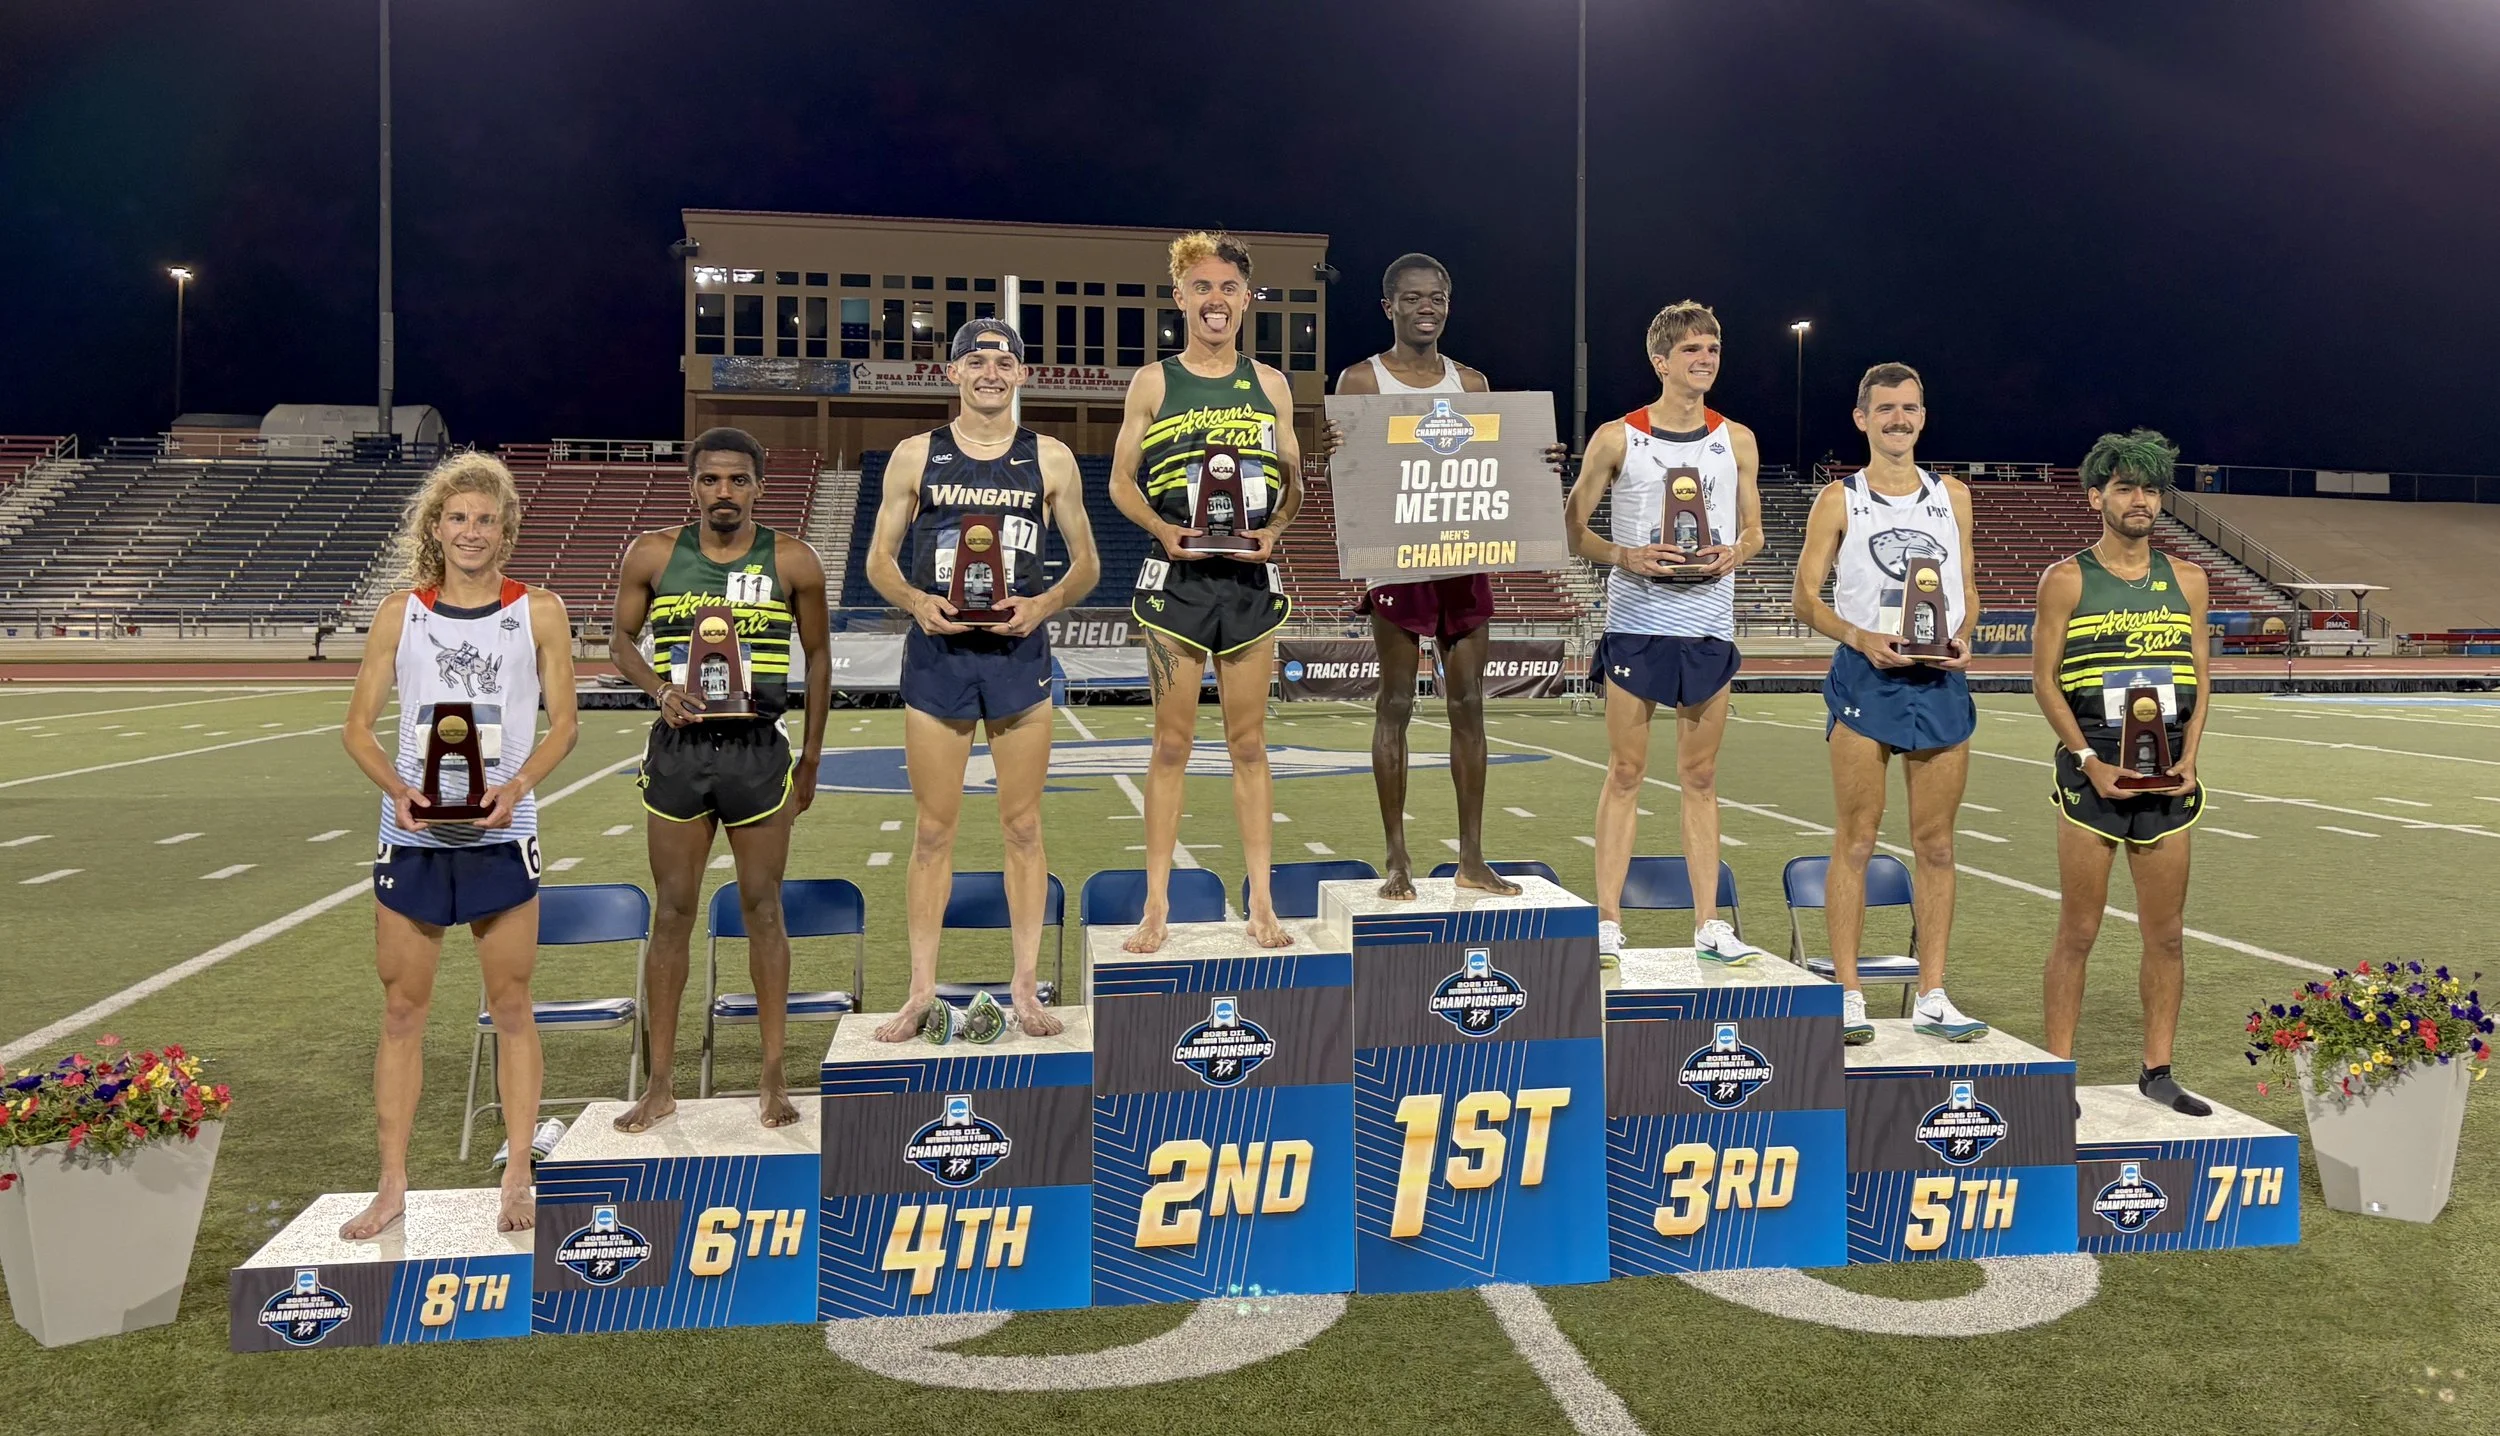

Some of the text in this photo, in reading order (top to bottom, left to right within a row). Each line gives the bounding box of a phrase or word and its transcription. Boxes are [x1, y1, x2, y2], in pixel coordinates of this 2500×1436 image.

[915, 364, 944, 374] PA
[1174, 403, 1254, 442] Adams
[1416, 427, 1474, 436] CHAMPIONSHIPS
[933, 454, 953, 464] SAC
[1212, 466, 1234, 474] NCAA
[1400, 458, 1498, 492] 10,000
[927, 484, 1036, 509] WINGATE
[1394, 490, 1510, 524] METERS
[1012, 520, 1033, 549] 17
[1440, 530, 1470, 541] MEN'S
[1396, 541, 1516, 568] CHAMPION
[736, 574, 762, 602] 11
[734, 612, 770, 636] ate
[1064, 622, 1128, 646] FIELD
[1976, 624, 2028, 642] TRACK
[2094, 604, 2170, 641] Adams
[2326, 621, 2348, 629] RMAC
[2124, 628, 2182, 659] State
[1306, 662, 1349, 679] TRACK
[1349, 662, 1360, 678] &
[1360, 662, 1380, 678] FIE
[1507, 661, 1518, 676] &
[1520, 660, 1559, 676] FIELD
[1432, 994, 1524, 1009] CHAMPIONSHIPS
[1176, 1042, 1272, 1059] CHAMPIONSHIPS
[1682, 1068, 1770, 1082] CHAMPIONSHIPS
[1918, 1124, 2004, 1138] CHAMPIONSHIPS
[908, 1142, 1008, 1158] CHAMPIONSHIPS
[1390, 1087, 1571, 1238] 1ST
[1134, 1139, 1314, 1248] 2ND
[1654, 1142, 1799, 1236] 3RD
[2205, 1166, 2284, 1222] 7TH
[1904, 1176, 2018, 1251] 5TH
[2096, 1198, 2166, 1210] CHAMPIONSHIPS
[559, 1246, 648, 1260] CHAMPIONSHIPS
[689, 1206, 806, 1276] 6TH
[882, 1204, 1032, 1295] 4TH
[420, 1273, 510, 1326] 8TH
[262, 1307, 348, 1322] CHAMPIONSHIPS
